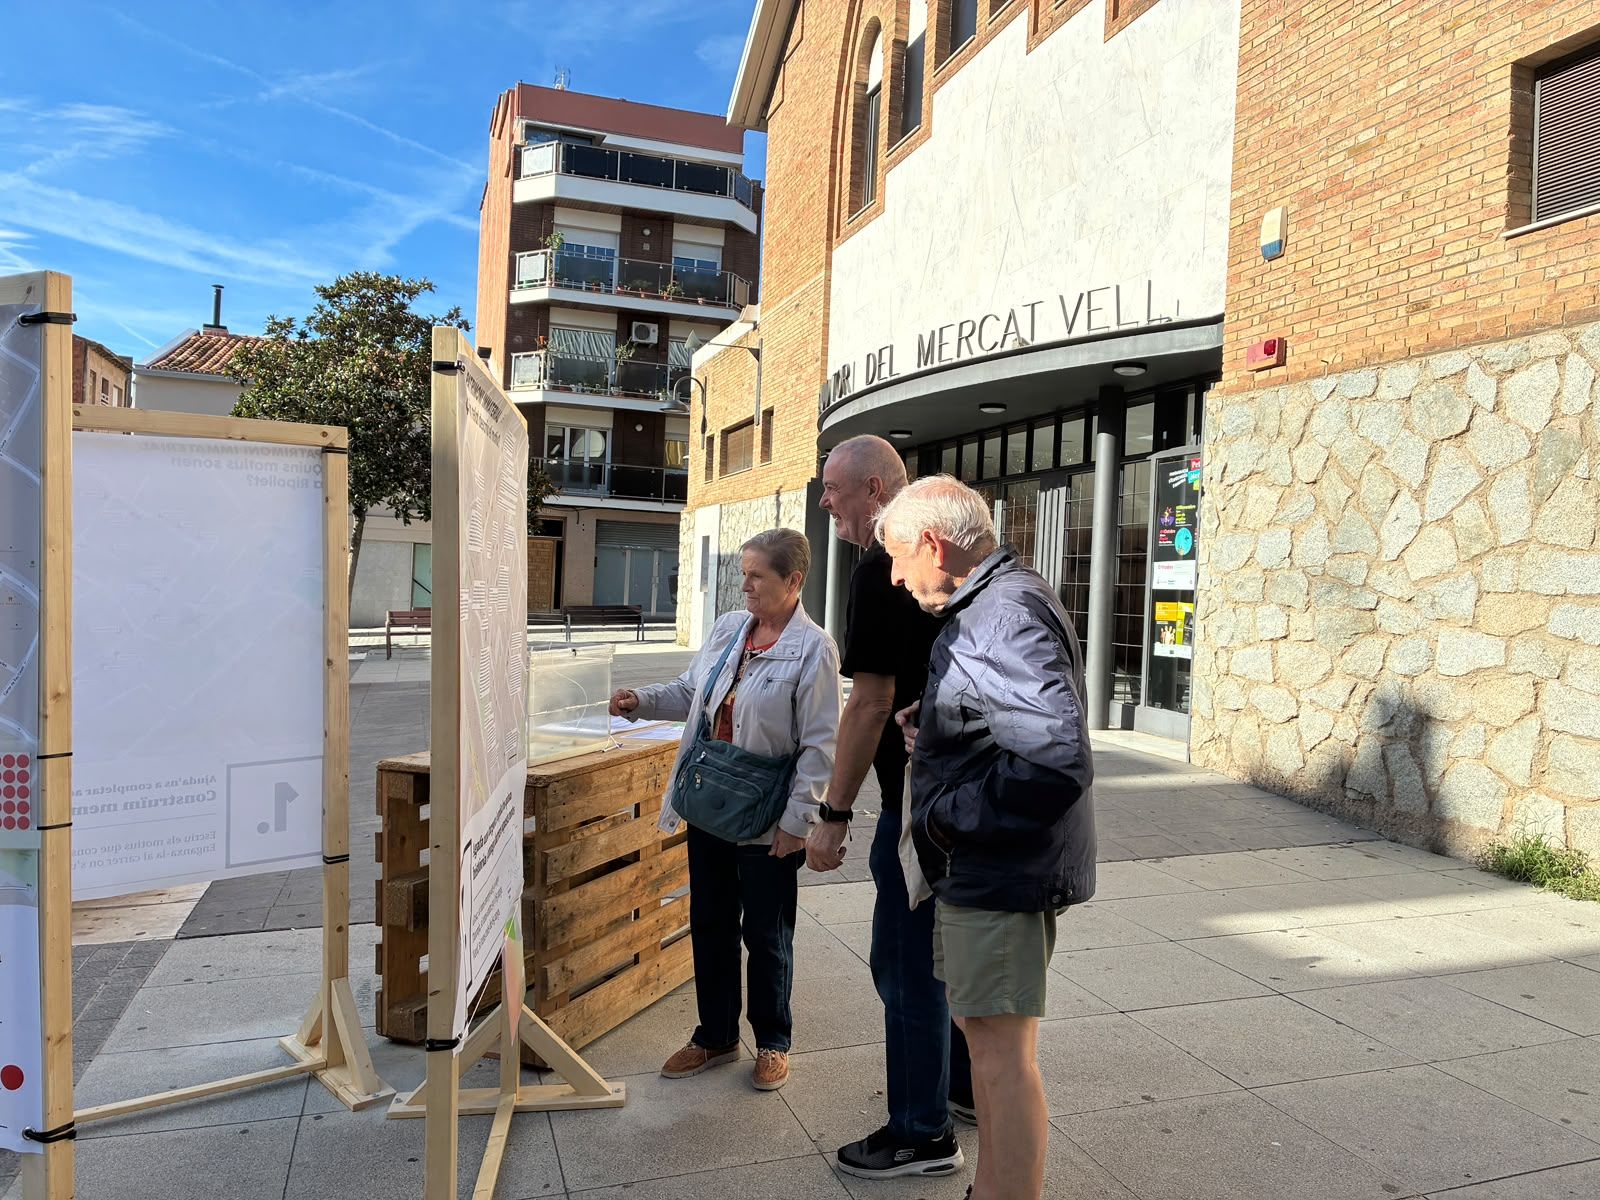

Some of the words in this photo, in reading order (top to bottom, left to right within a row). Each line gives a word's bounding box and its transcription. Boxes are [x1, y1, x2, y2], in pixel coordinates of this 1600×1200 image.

[865, 344, 900, 387] DEL
[917, 300, 1045, 369] MERCAT
[1059, 279, 1169, 335] VELL
